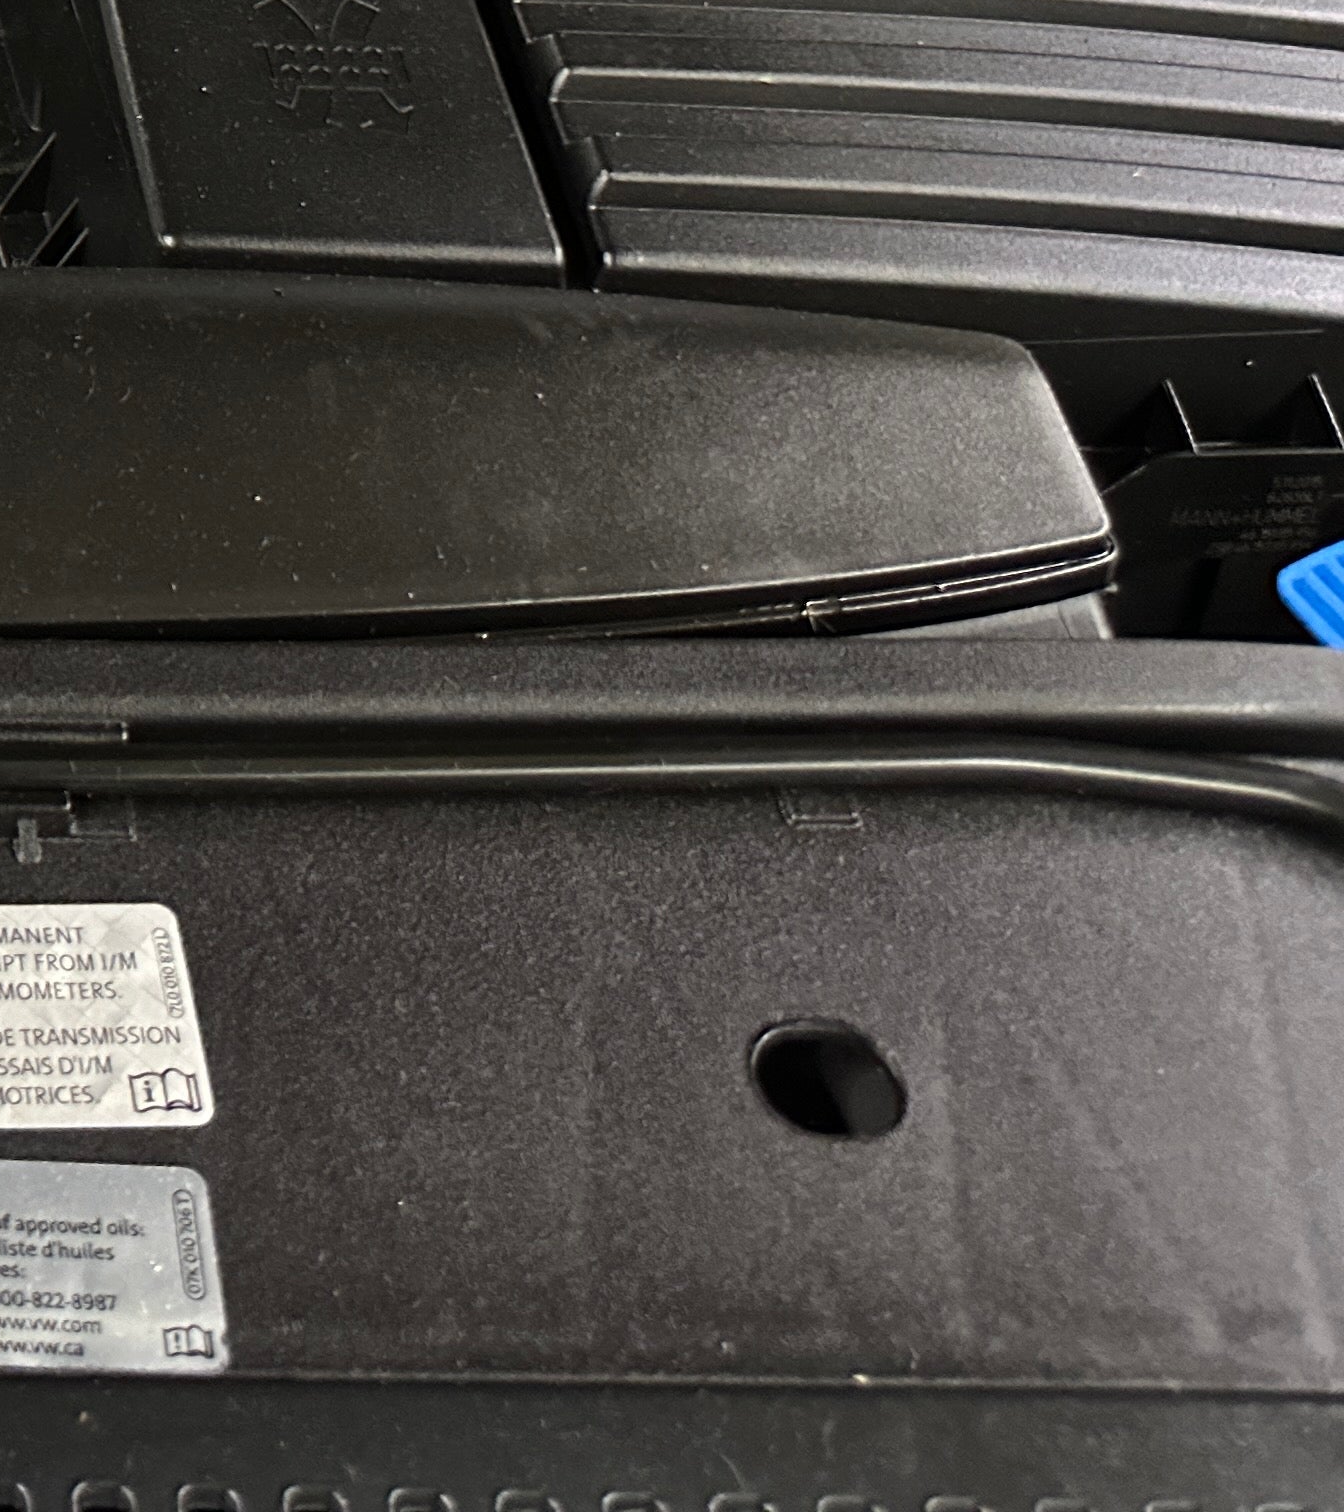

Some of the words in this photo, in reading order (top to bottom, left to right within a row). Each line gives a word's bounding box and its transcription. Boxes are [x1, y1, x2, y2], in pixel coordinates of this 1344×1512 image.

[35, 954, 93, 971] FROM
[101, 952, 137, 970] I/M
[15, 1218, 102, 1237] approved
[106, 1220, 145, 1236] oils:
[41, 1240, 114, 1260] d'huiles
